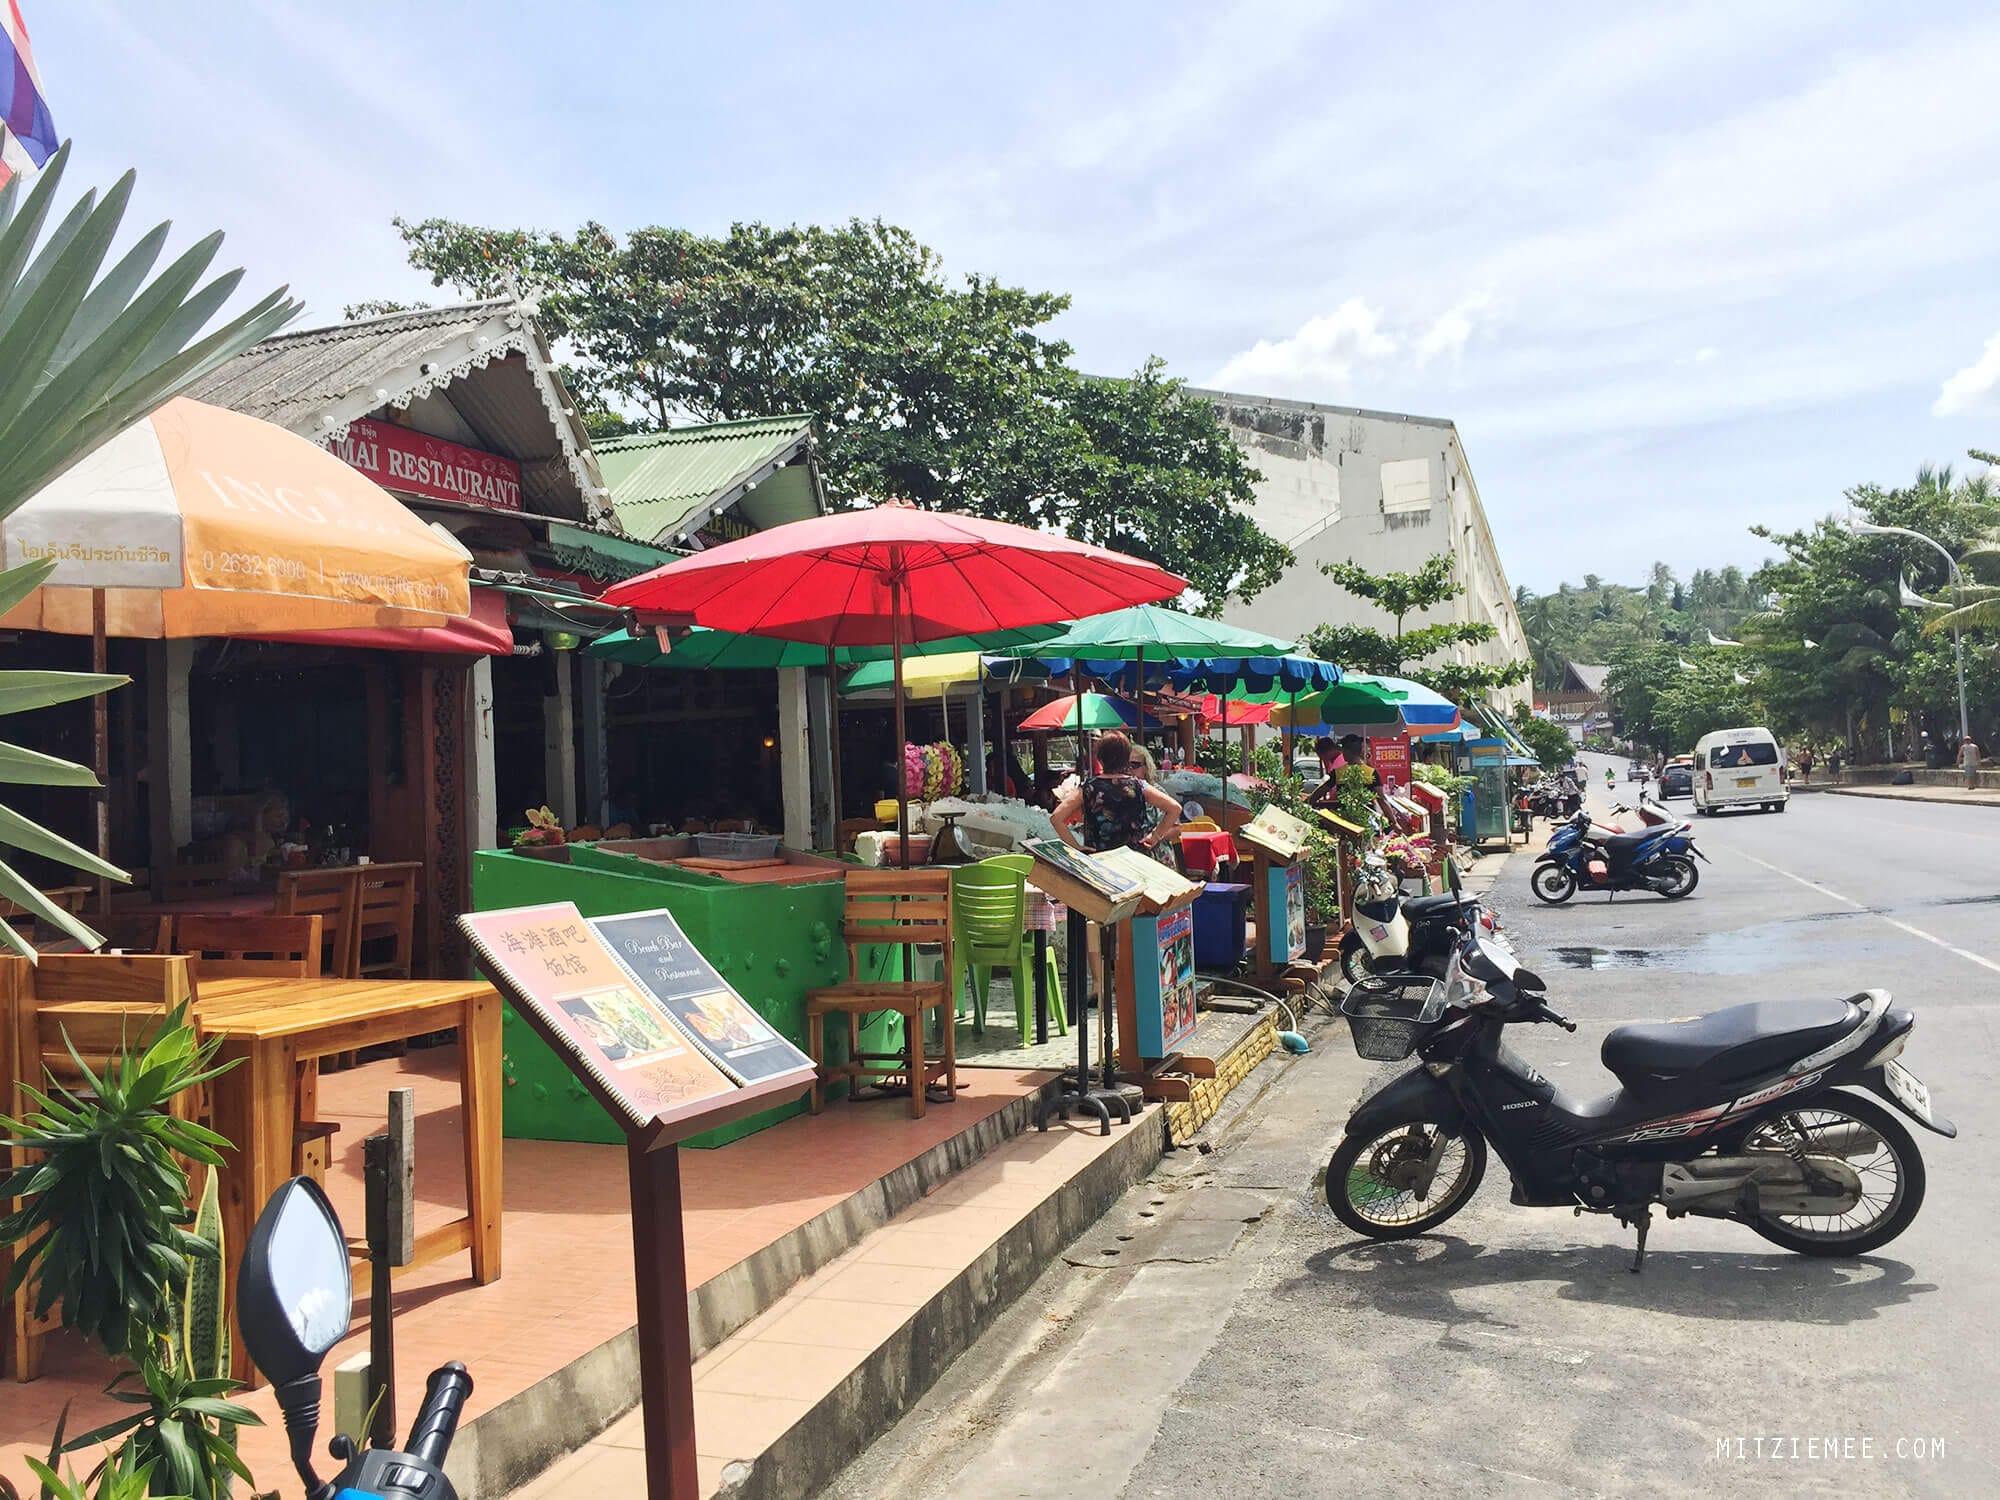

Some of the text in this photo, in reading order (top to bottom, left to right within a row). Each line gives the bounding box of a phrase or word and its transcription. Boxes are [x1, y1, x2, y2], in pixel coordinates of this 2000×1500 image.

[328, 438, 521, 507] MAI RESTAURANT
[198, 470, 328, 525] ING
[203, 551, 215, 571] 0
[219, 551, 263, 576] 2632
[266, 556, 307, 580] 6000
[500, 924, 588, 954] 海滩酒吧
[656, 935, 682, 951] Bar
[658, 951, 674, 963] and
[1502, 1100, 1539, 1111] HONDA
